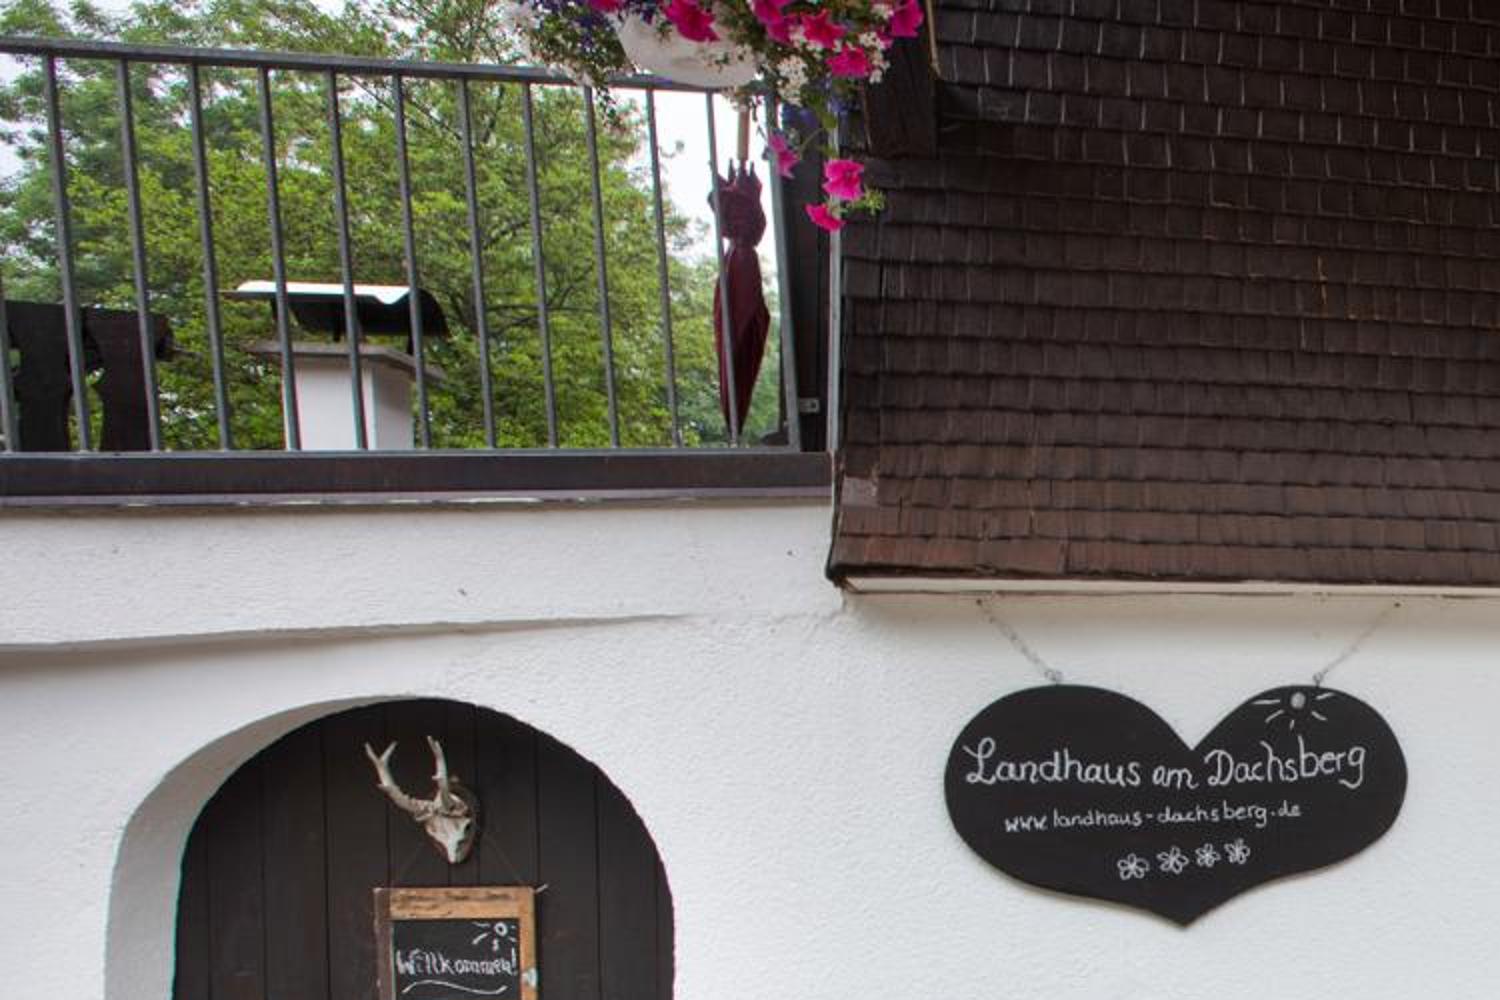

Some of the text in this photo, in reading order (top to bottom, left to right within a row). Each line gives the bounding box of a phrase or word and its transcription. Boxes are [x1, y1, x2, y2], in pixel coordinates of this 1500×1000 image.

[962, 735, 1367, 789] Landhaus am Dachsberg
[396, 948, 517, 975] Willkommen!
